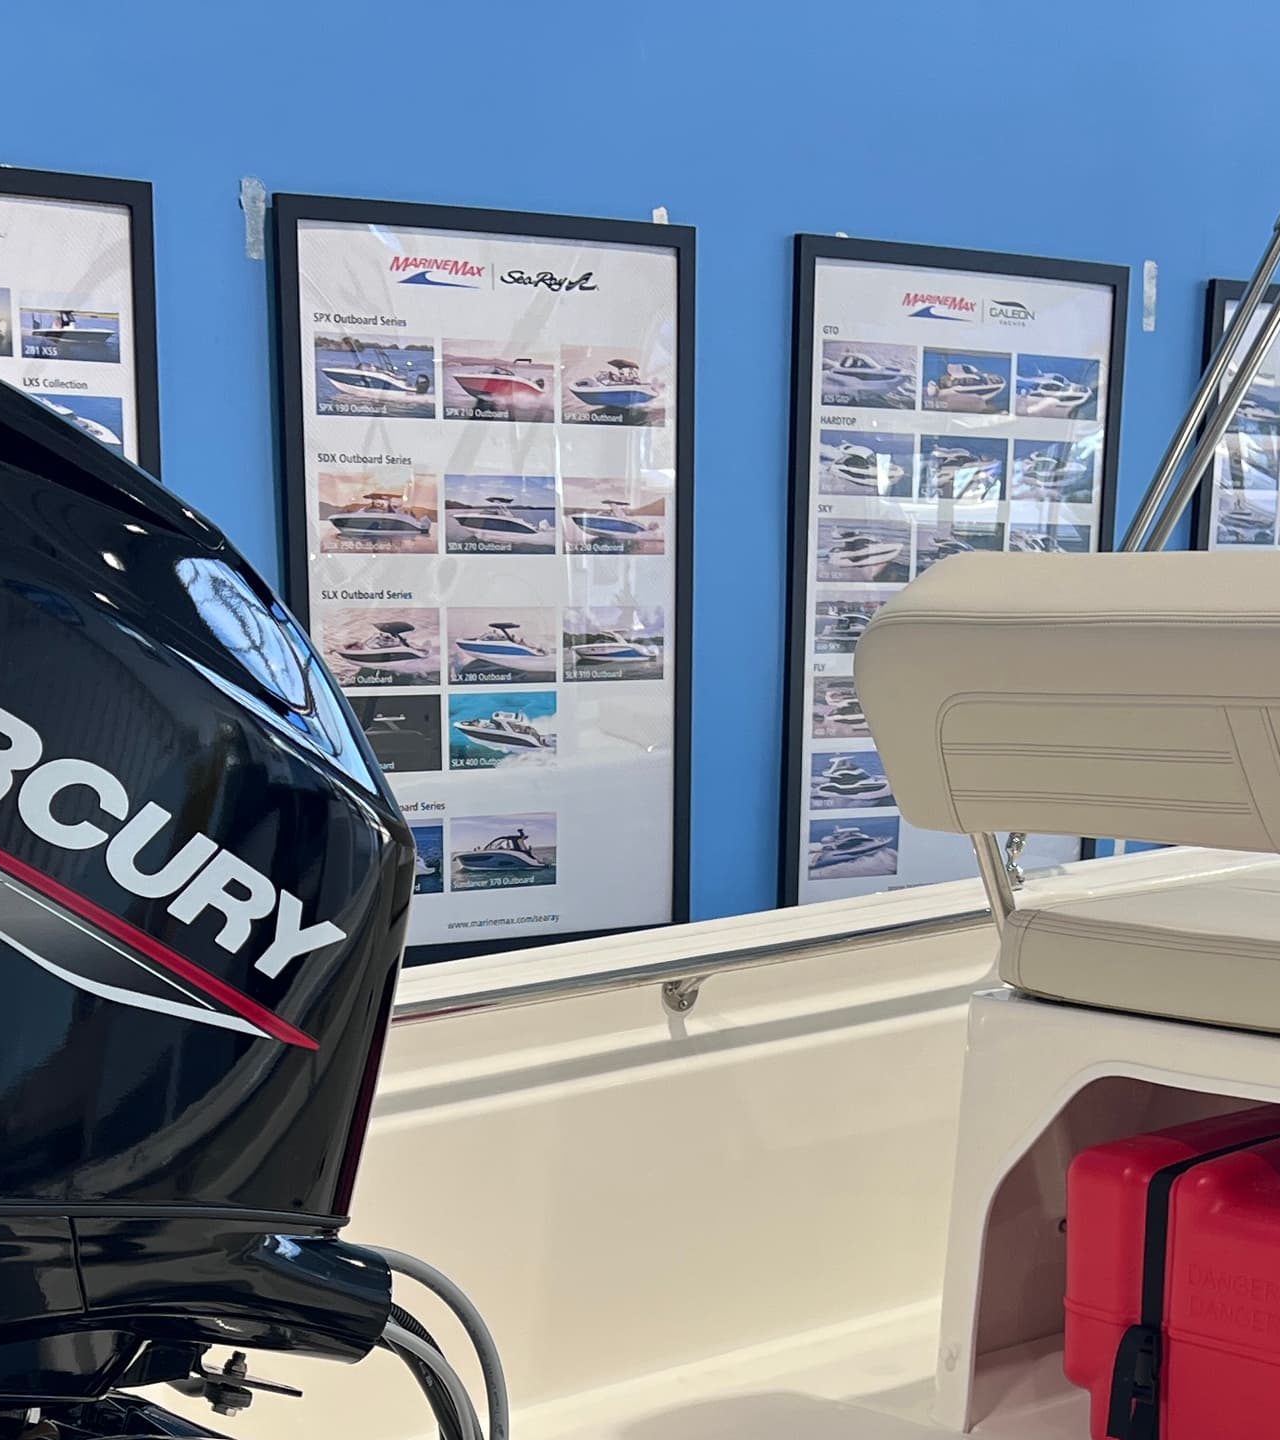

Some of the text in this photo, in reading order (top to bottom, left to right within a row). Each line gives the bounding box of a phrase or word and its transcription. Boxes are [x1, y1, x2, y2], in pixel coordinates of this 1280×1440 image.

[989, 307, 1035, 321] GALEON
[314, 313, 407, 327] SPX Outboard Series
[23, 377, 88, 390] LXS Collection
[351, 404, 387, 414] Outboard
[475, 409, 508, 418] Outboard
[591, 414, 623, 422] Outboard
[820, 416, 857, 426] HARDTOP
[318, 453, 412, 465] SDX Outboard Series
[478, 542, 512, 551] Outboard
[322, 590, 412, 600] SLX Outboard Series
[480, 671, 512, 682] Outboard
[591, 669, 623, 679] Outboard
[421, 801, 446, 811] Series
